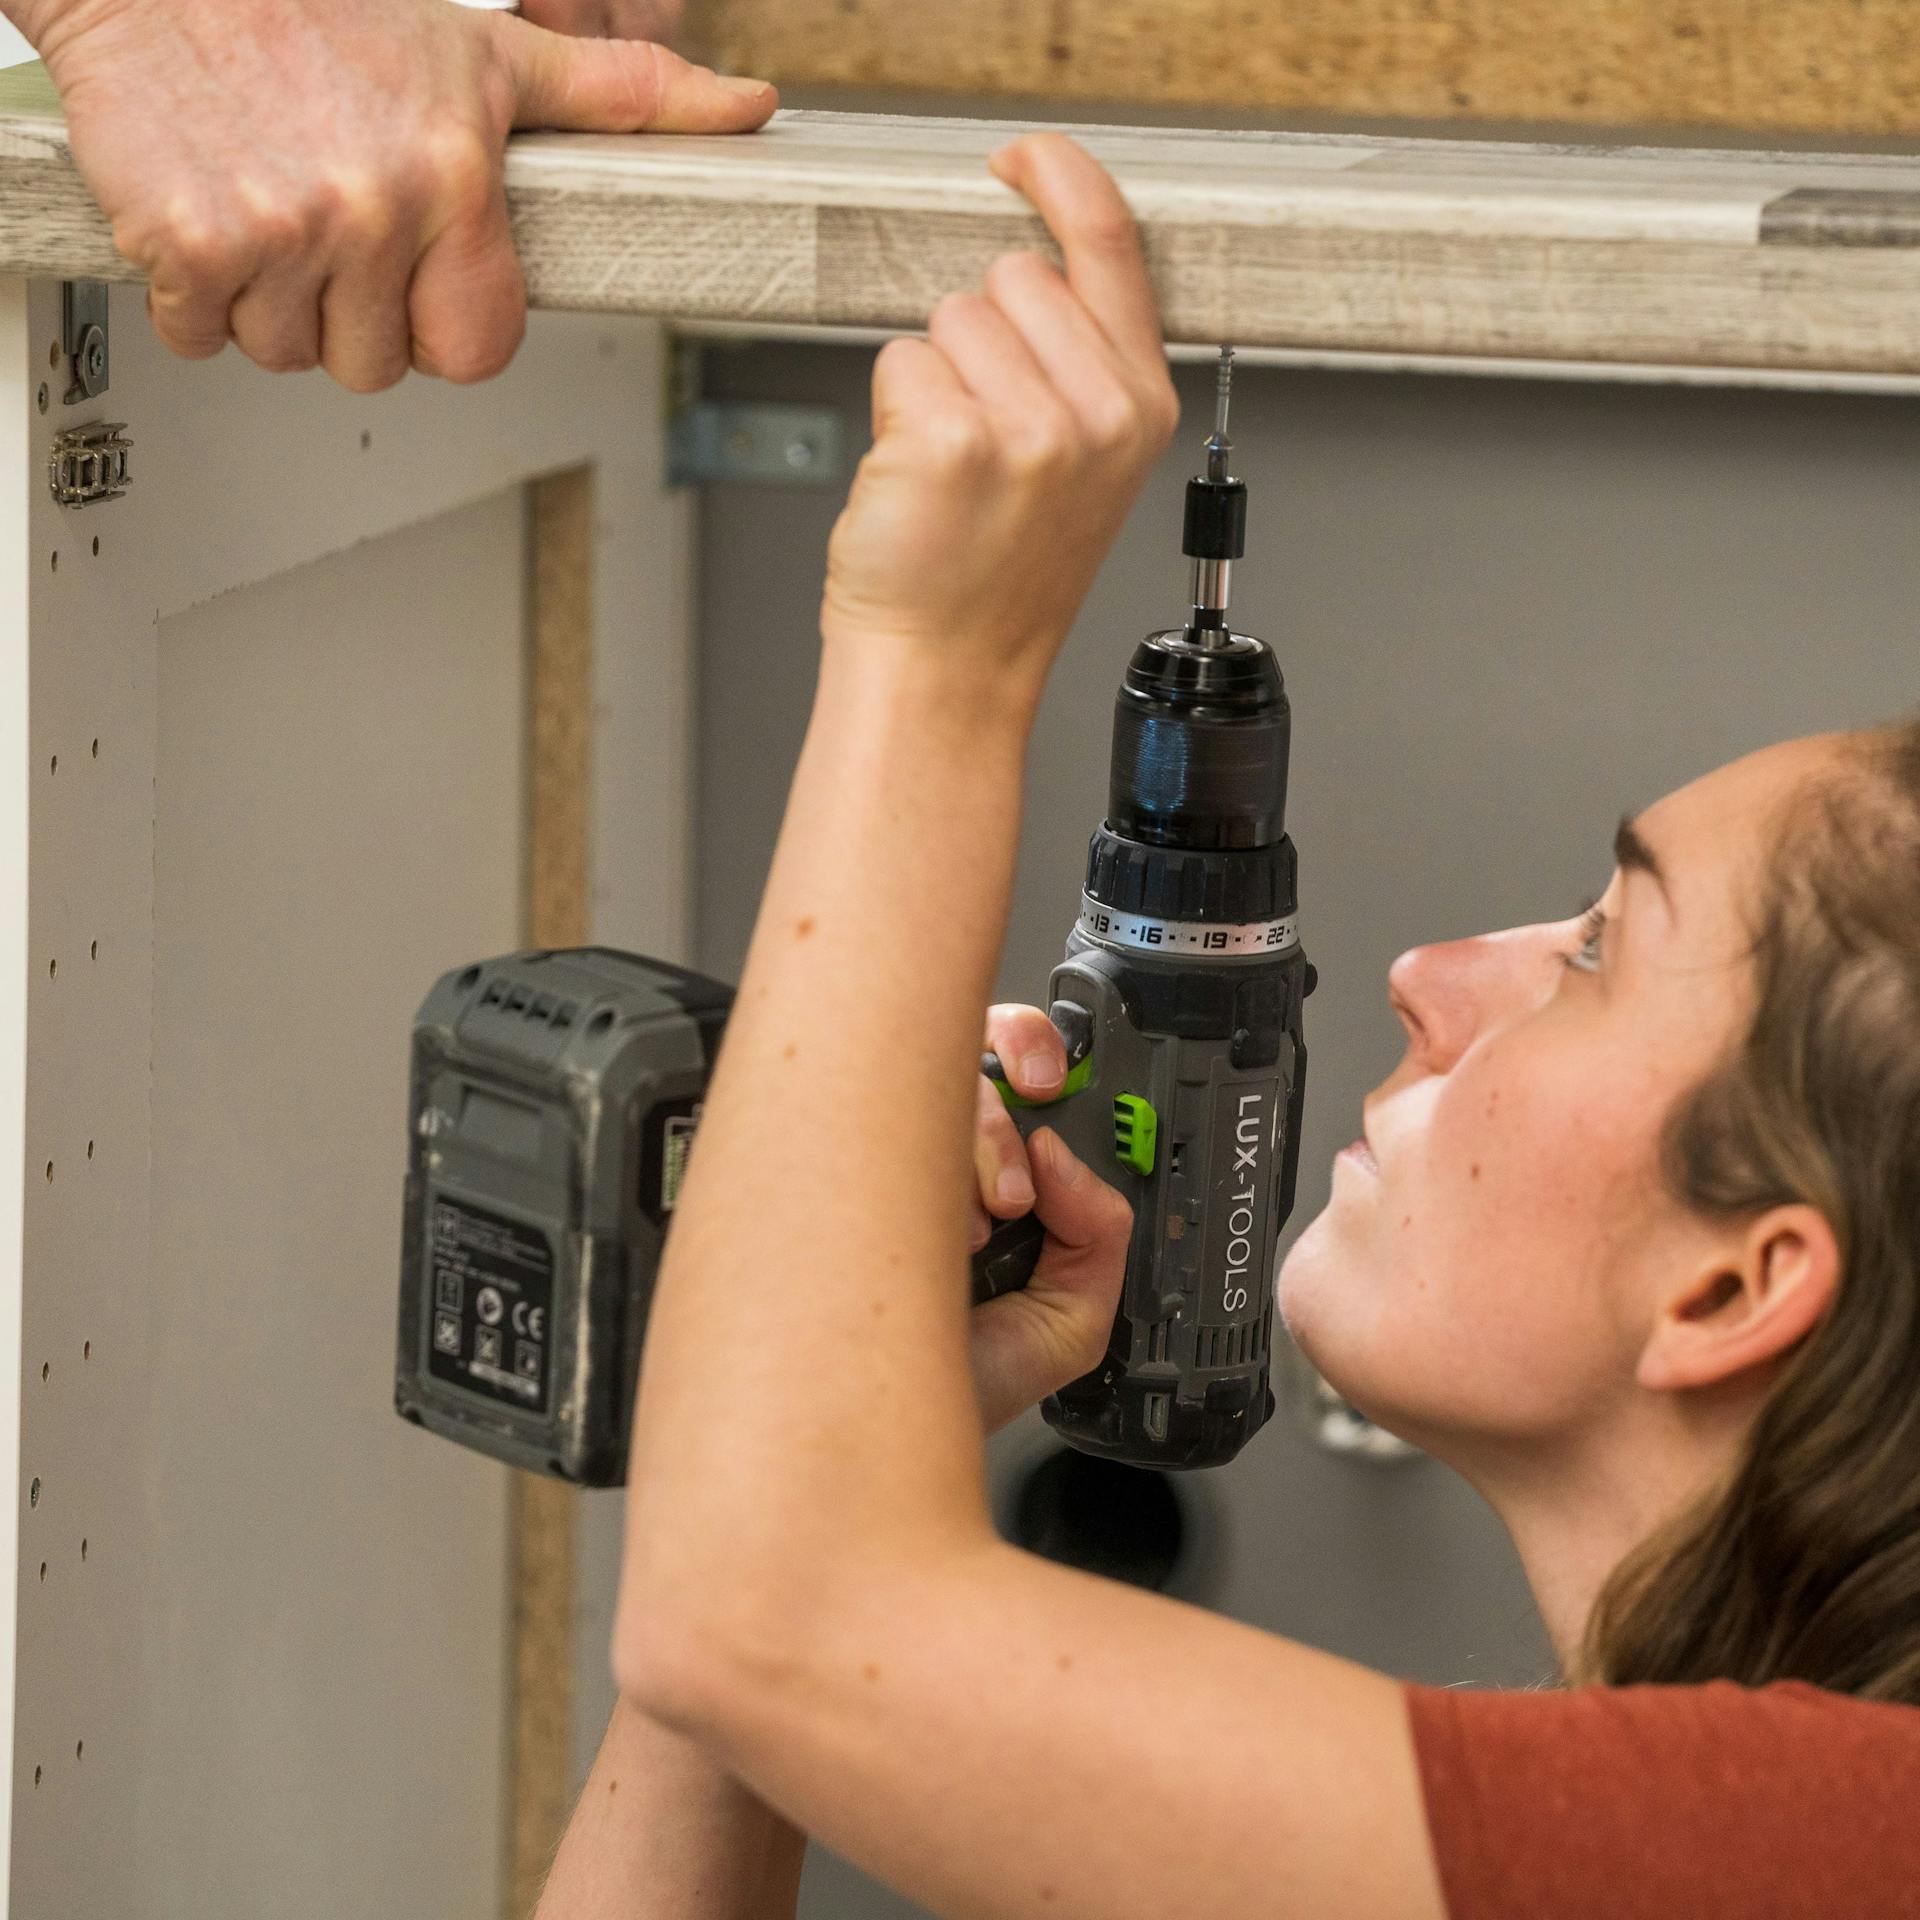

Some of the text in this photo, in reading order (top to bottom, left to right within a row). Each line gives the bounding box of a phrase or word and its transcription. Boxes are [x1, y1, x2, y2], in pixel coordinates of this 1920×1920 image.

[1094, 916, 1285, 949] 13 16 19 22
[1222, 1094, 1263, 1313] LUX-TOOLS
[511, 1300, 545, 1342] CE
